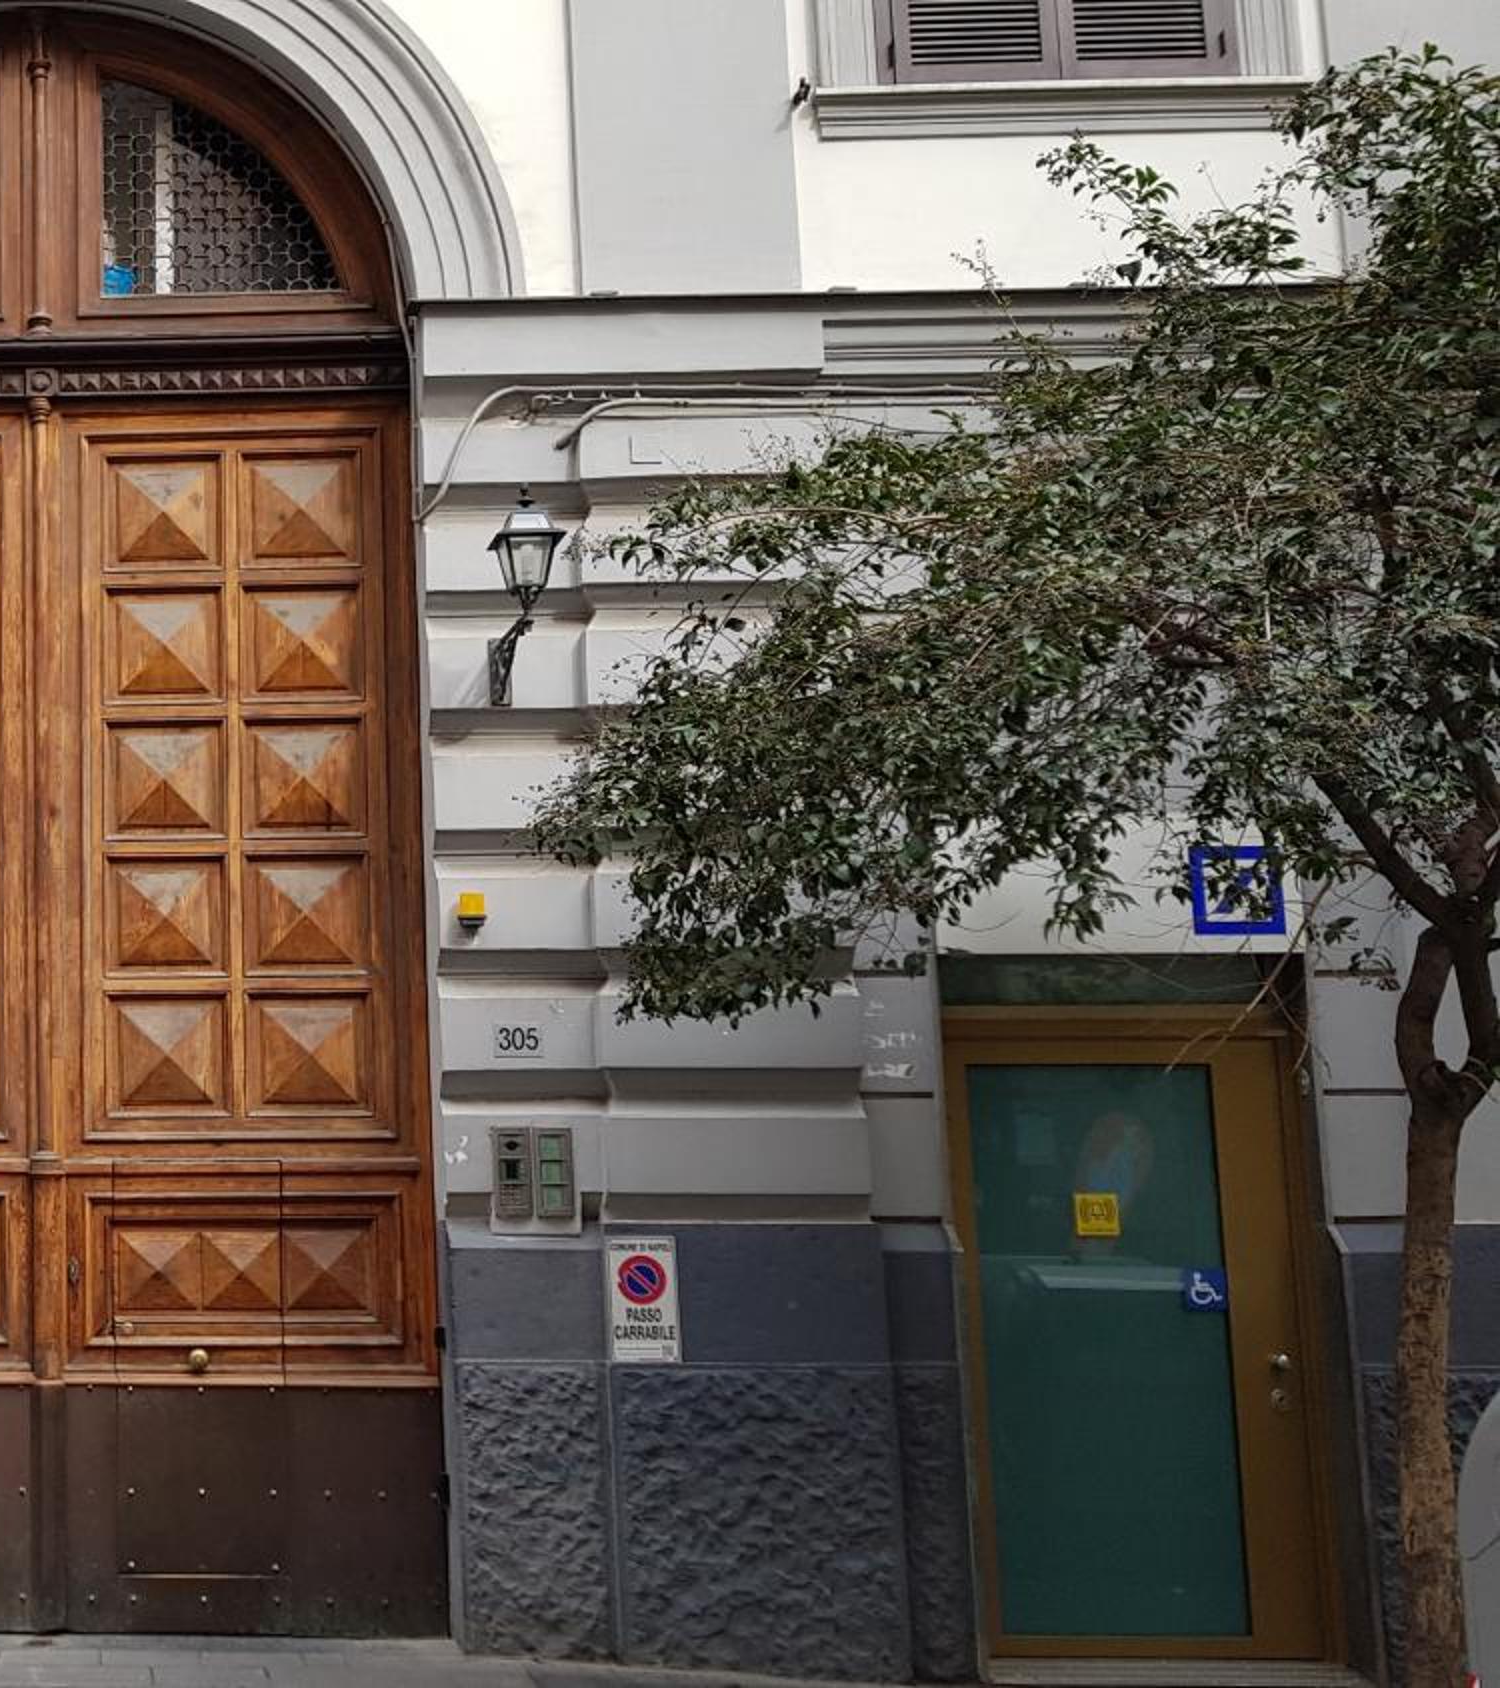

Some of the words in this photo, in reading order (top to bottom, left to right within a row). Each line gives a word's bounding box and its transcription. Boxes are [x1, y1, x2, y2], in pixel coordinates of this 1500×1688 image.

[499, 1027, 540, 1051] 305
[626, 1307, 662, 1323] PASSO
[614, 1324, 677, 1340] CARRABILE
